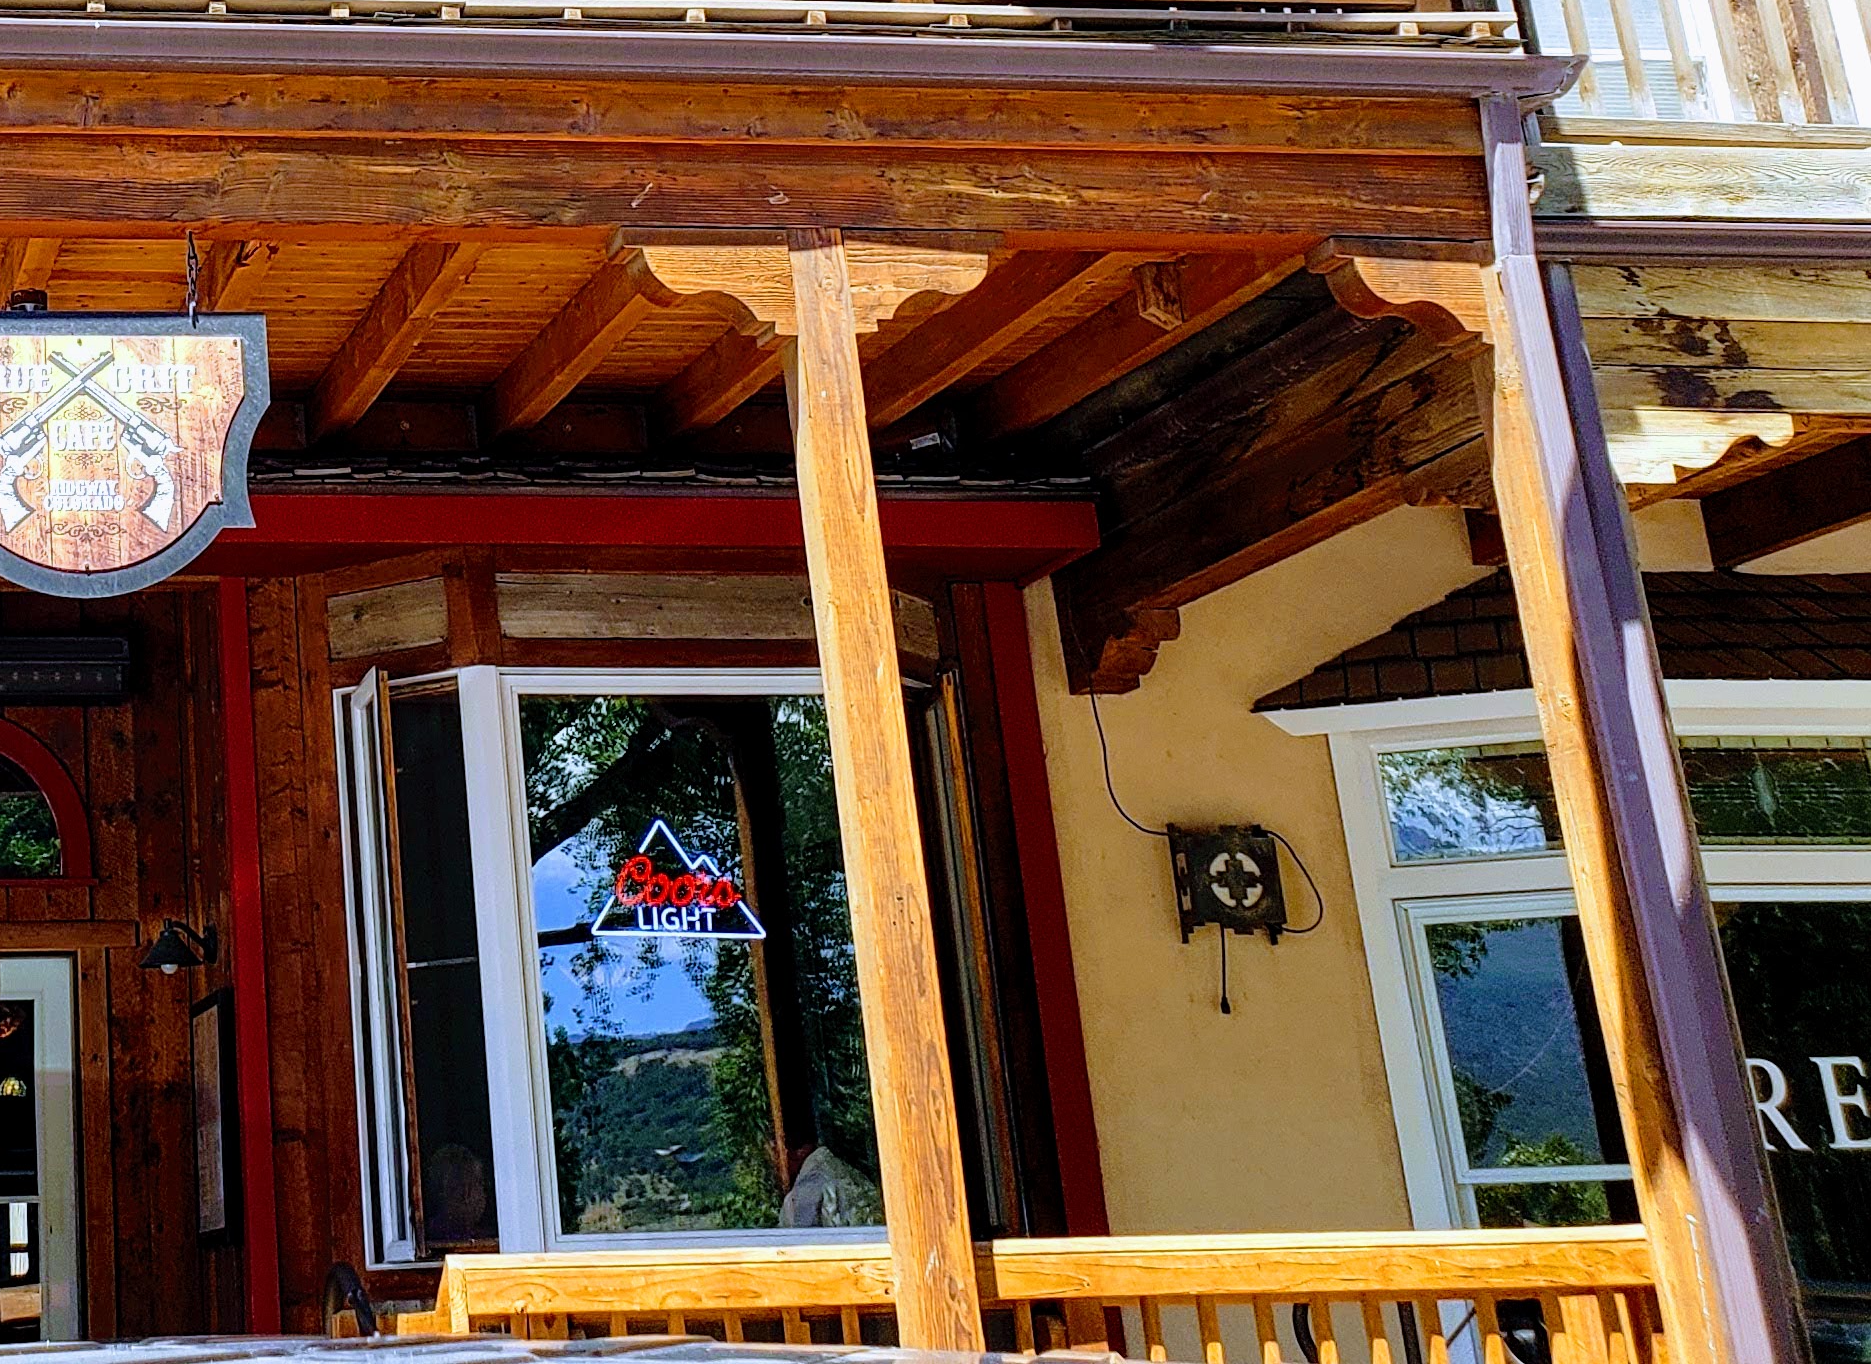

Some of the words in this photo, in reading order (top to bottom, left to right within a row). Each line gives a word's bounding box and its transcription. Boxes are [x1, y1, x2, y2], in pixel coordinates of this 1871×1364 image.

[107, 364, 197, 393] GRIT
[43, 495, 126, 511] COLORADO
[615, 853, 742, 909] Coors
[636, 906, 717, 932] LIGHT
